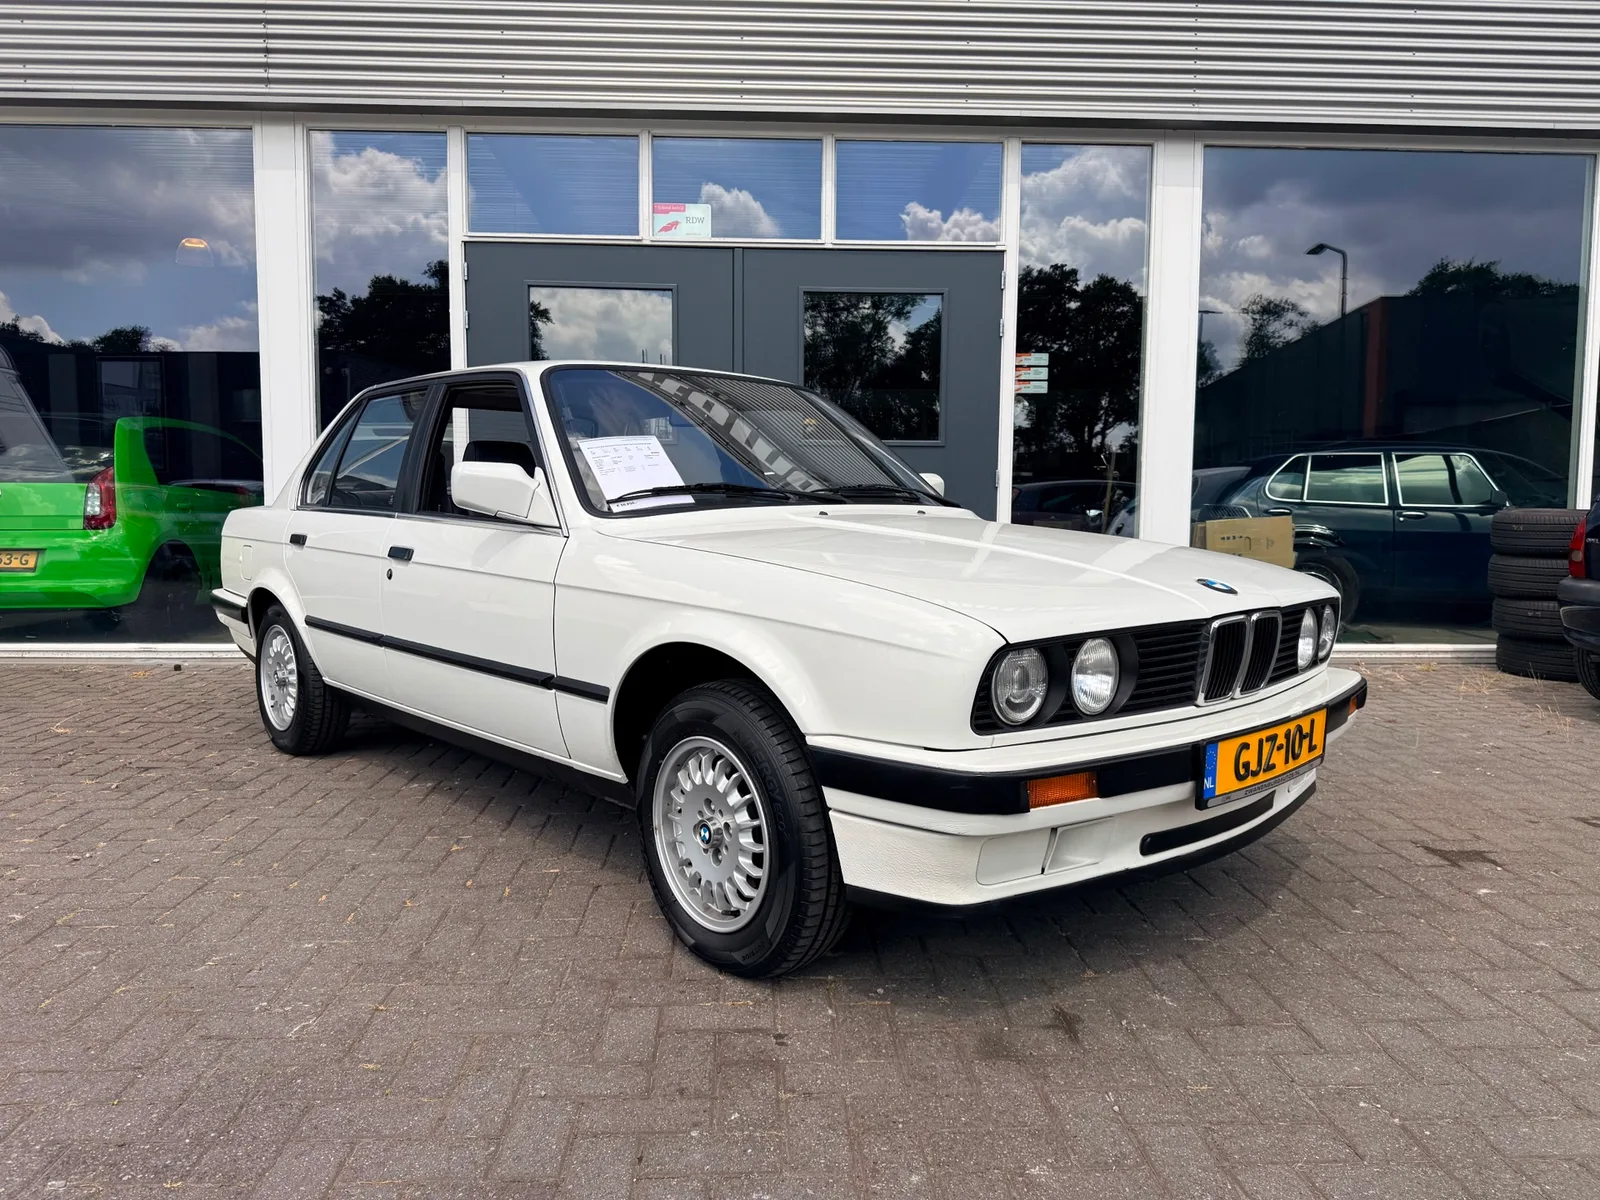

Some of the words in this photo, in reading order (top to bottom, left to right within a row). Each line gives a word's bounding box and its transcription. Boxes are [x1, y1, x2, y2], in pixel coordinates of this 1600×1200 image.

[685, 216, 705, 224] RDW
[0, 552, 30, 566] 3-G
[1234, 718, 1318, 781] GJZ-10-L
[1203, 776, 1215, 790] NL
